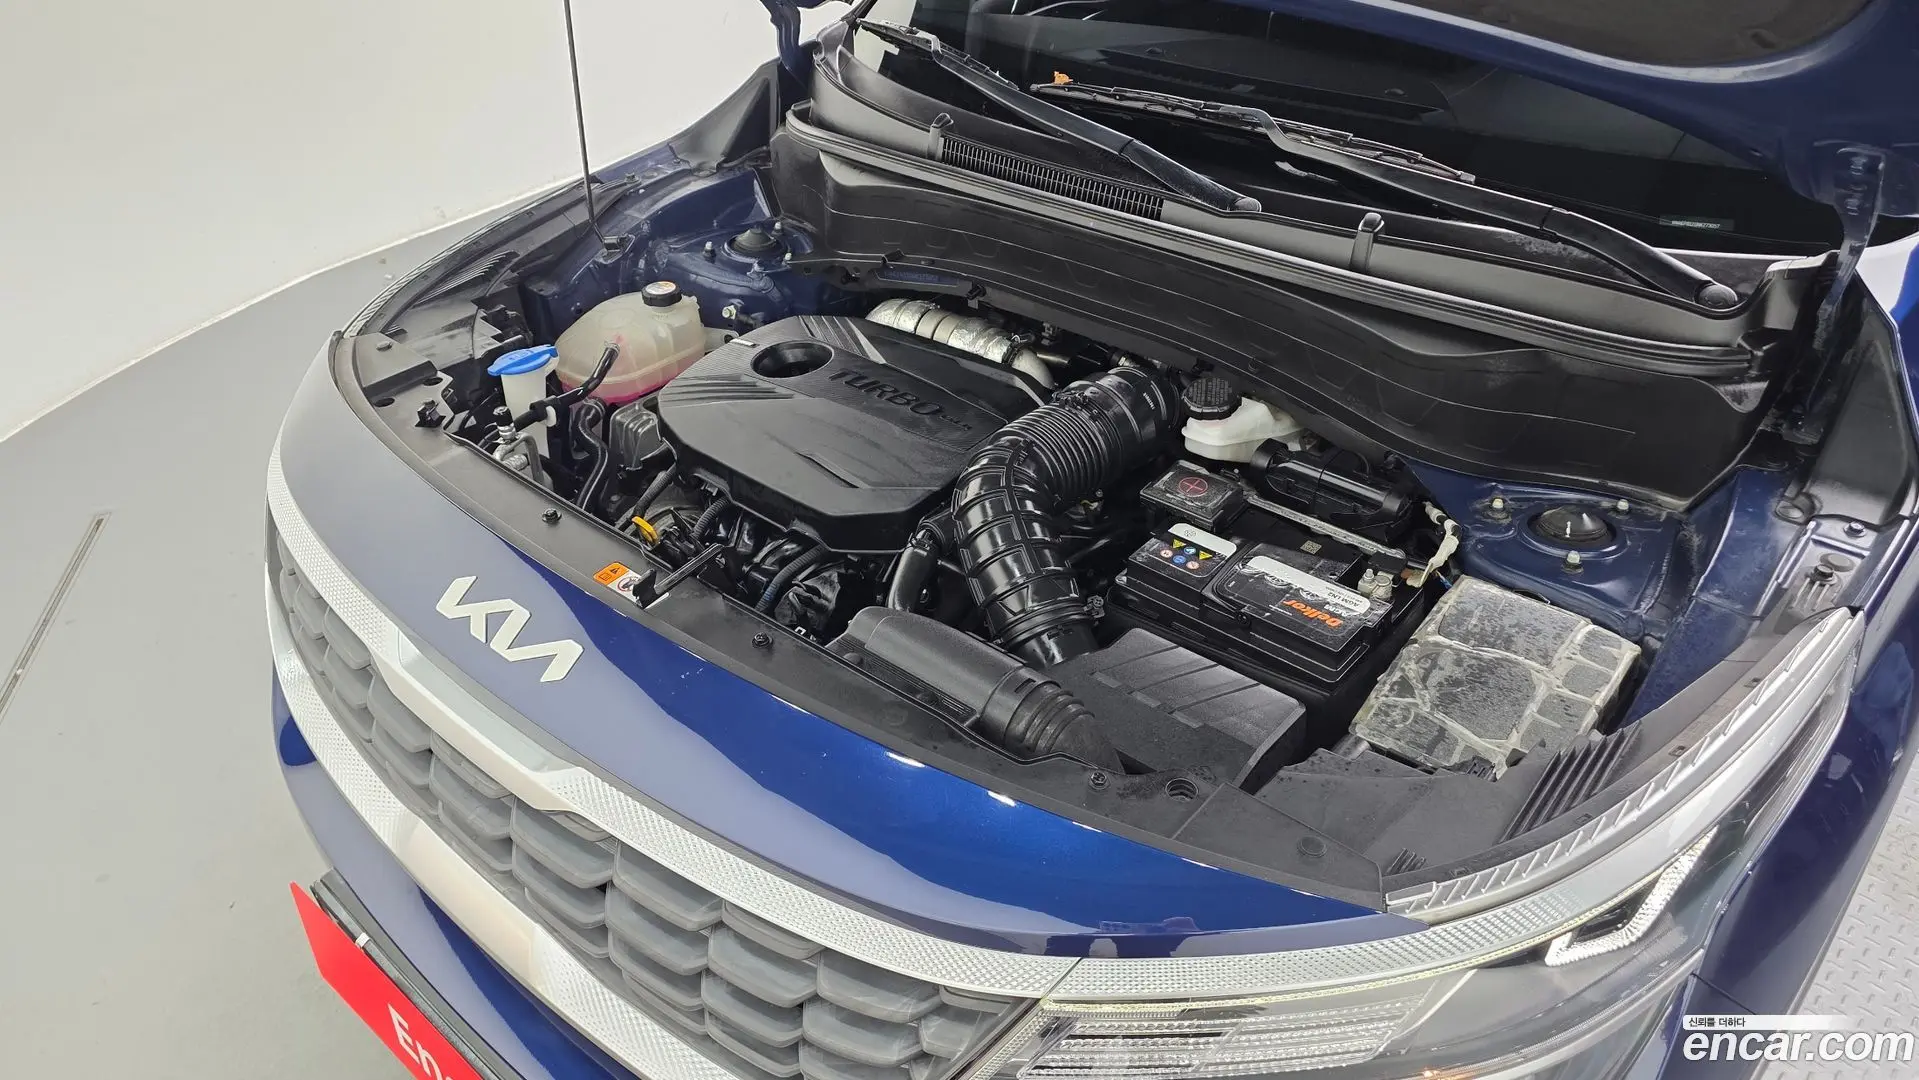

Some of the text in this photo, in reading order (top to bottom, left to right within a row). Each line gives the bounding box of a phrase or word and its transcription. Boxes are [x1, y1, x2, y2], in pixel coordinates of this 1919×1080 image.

[829, 368, 943, 415] TURBO
[436, 576, 585, 683] KIA
[1283, 599, 1344, 627] Delkor
[387, 1003, 453, 1080] En
